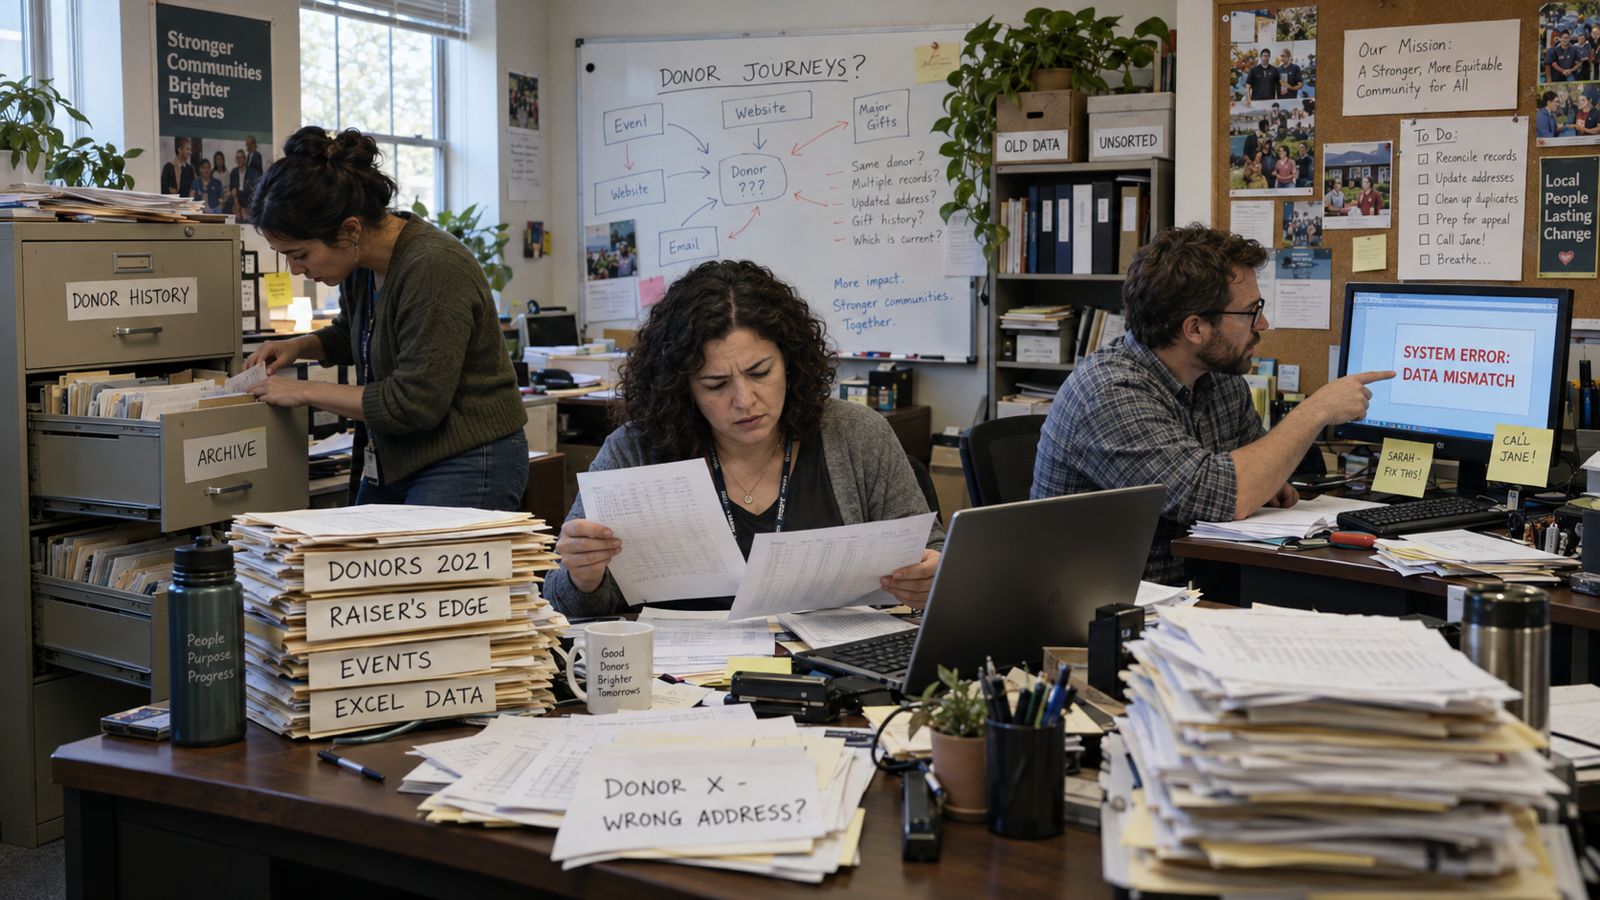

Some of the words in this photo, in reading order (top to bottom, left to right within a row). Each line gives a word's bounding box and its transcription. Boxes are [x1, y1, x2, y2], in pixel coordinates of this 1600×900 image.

[167, 30, 233, 59] Stronger
[1359, 42, 1387, 57] Our
[1399, 38, 1451, 53] Mission:
[167, 53, 262, 84] Communities
[660, 65, 721, 88] DONOR
[743, 55, 865, 81] JOURNEYS?
[1358, 65, 1366, 78] A
[1373, 64, 1421, 80] Stronger,
[1428, 61, 1451, 73] More
[1455, 56, 1502, 77] Equitable
[169, 76, 230, 99] Brighter
[1357, 82, 1420, 99] Community
[1429, 79, 1446, 92] for
[1454, 78, 1468, 92] All
[169, 98, 224, 119] Futures
[736, 102, 788, 121] Website
[859, 104, 891, 117] Major
[615, 114, 646, 133] Event
[867, 116, 896, 130] Gifts
[1100, 134, 1157, 149] UNSORTED
[1414, 129, 1429, 143] To
[1436, 128, 1458, 140] Do:
[1005, 140, 1027, 152] OLD
[1033, 138, 1060, 152] DATA
[852, 161, 879, 172] Same
[887, 151, 924, 168] donor?
[1436, 150, 1477, 163] Reconcile
[1484, 149, 1517, 161] records
[731, 166, 766, 178] Donor
[852, 174, 893, 191] Multiple
[899, 169, 940, 184] records?
[1436, 172, 1467, 187] Update
[1472, 171, 1514, 183] addresses
[1546, 173, 1579, 187] Local
[611, 183, 648, 200] Website
[739, 179, 765, 197] ???
[852, 194, 890, 211] Updated
[896, 190, 936, 204] address?
[1435, 193, 1458, 204] Clean
[1462, 197, 1472, 208] up
[1476, 192, 1518, 208] duplicates
[1546, 191, 1588, 207] People
[852, 213, 873, 226] Gift
[882, 210, 924, 228] history?
[1437, 213, 1457, 228] Prep
[1463, 212, 1477, 224] for
[1480, 213, 1510, 229] appeal
[1545, 209, 1592, 225] Lasting
[853, 233, 880, 245] Which
[887, 234, 895, 244] is
[901, 230, 942, 243] current?
[1436, 233, 1454, 245] Call
[1459, 233, 1485, 246] Jane!
[1544, 227, 1591, 242] Change
[670, 237, 700, 255] Email
[1438, 252, 1491, 265] Breathe...
[834, 278, 859, 289] More
[867, 272, 904, 289] impact.
[73, 290, 119, 309] DONOR
[130, 286, 189, 305] HISTORY
[833, 299, 878, 315] Stronger
[885, 291, 953, 307] communities.
[842, 315, 895, 335] Together.
[1404, 346, 1455, 361] SYSTEM
[1461, 349, 1510, 363] ERROR:
[1403, 368, 1438, 382] DATA
[1444, 370, 1514, 387] MISMATCH
[1503, 433, 1530, 445] CALL
[198, 440, 256, 466] ARCHIVE
[1388, 451, 1414, 462] SARAH
[1500, 450, 1536, 465] JANE!
[1384, 467, 1397, 476] FIX
[1401, 469, 1422, 480] THIS!
[328, 557, 421, 581] DONORS
[438, 551, 489, 573] 2021
[330, 598, 426, 628] RAISER'S
[439, 596, 488, 617] EDGE
[186, 631, 224, 650] People
[186, 651, 231, 667] Purpose
[601, 647, 624, 658] Good
[341, 651, 431, 679] EVENTS
[600, 662, 629, 671] Donors
[189, 669, 233, 686] Progress
[598, 675, 632, 688] Brighter
[597, 688, 640, 697] Tomorrows
[336, 694, 404, 718] EXCEL
[425, 687, 483, 708] DATA
[605, 779, 686, 799] DONOR
[708, 776, 724, 794] X
[603, 811, 681, 831] WRONG
[698, 799, 806, 826] ADDRESS?
